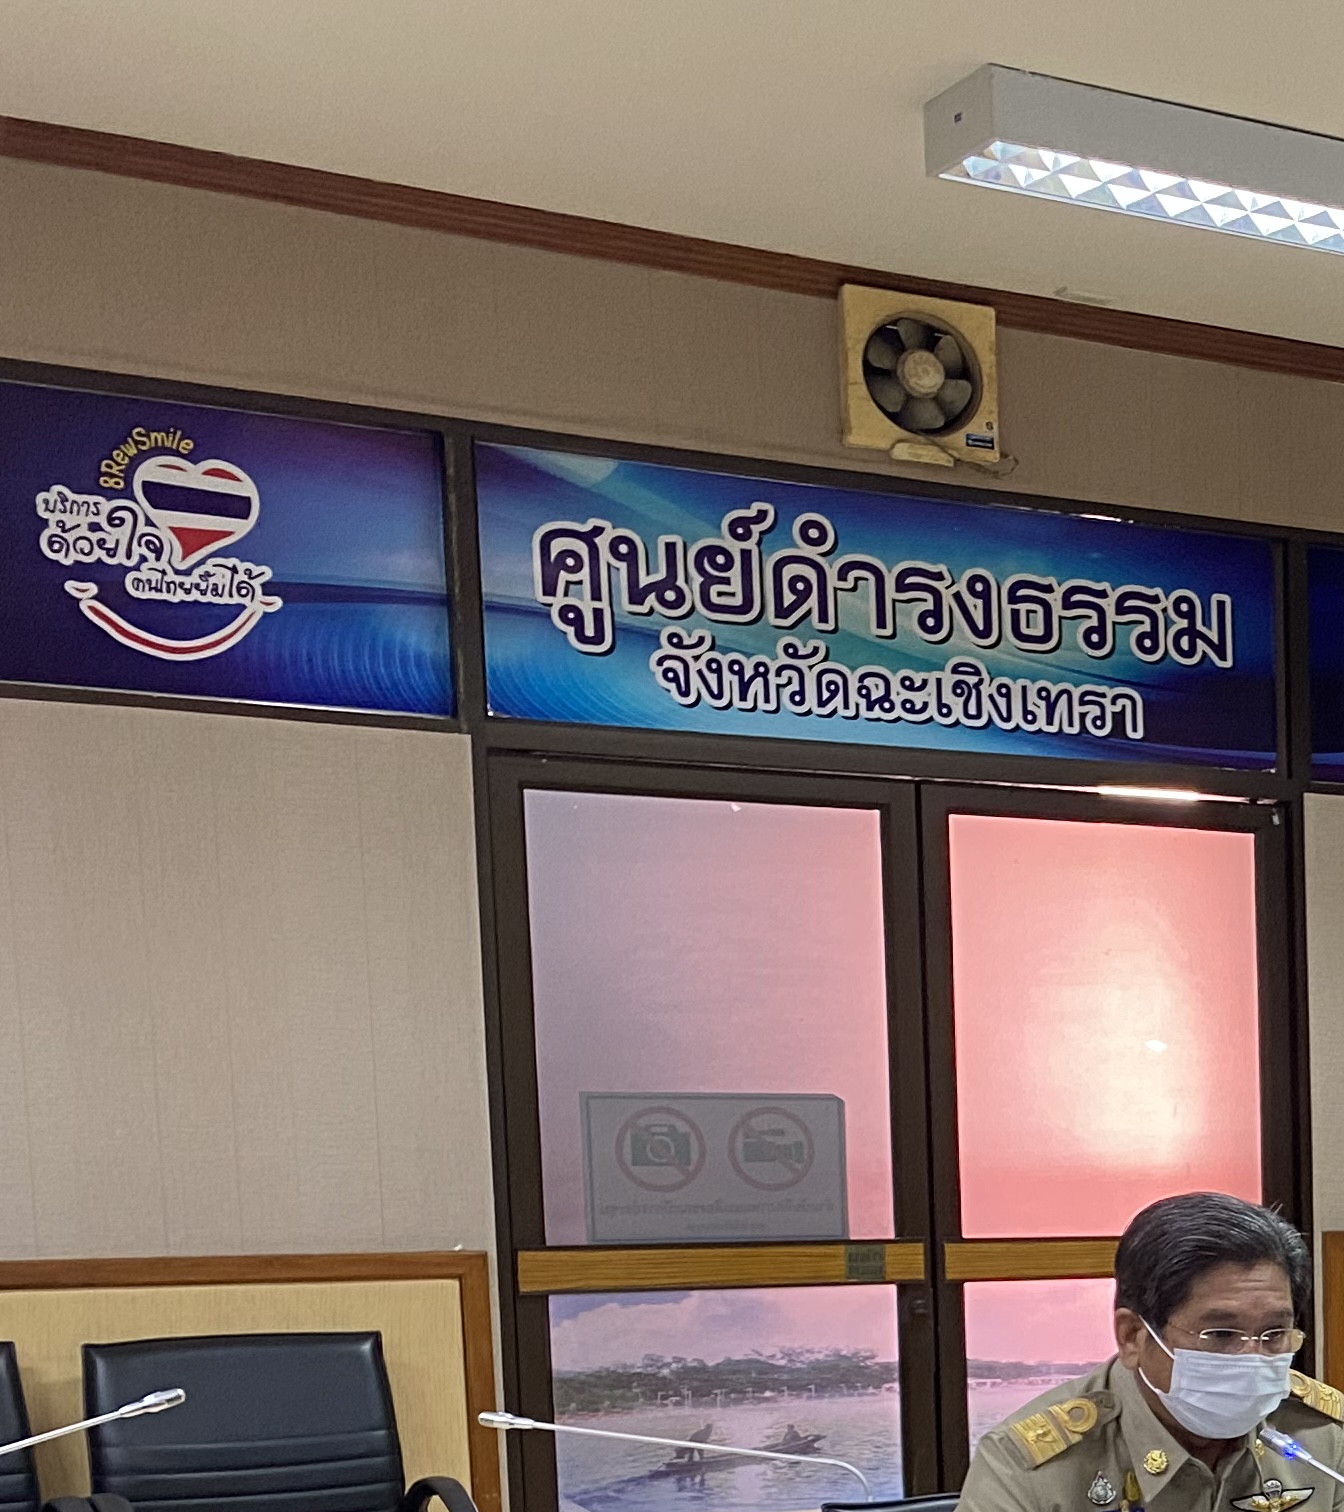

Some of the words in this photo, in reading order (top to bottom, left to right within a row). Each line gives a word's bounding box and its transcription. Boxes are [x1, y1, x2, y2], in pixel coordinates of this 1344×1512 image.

[537, 505, 1232, 667] ศูนย์ดำรงธรรม
[655, 632, 1143, 738] จังหวัดฉะเชิงเทรา
